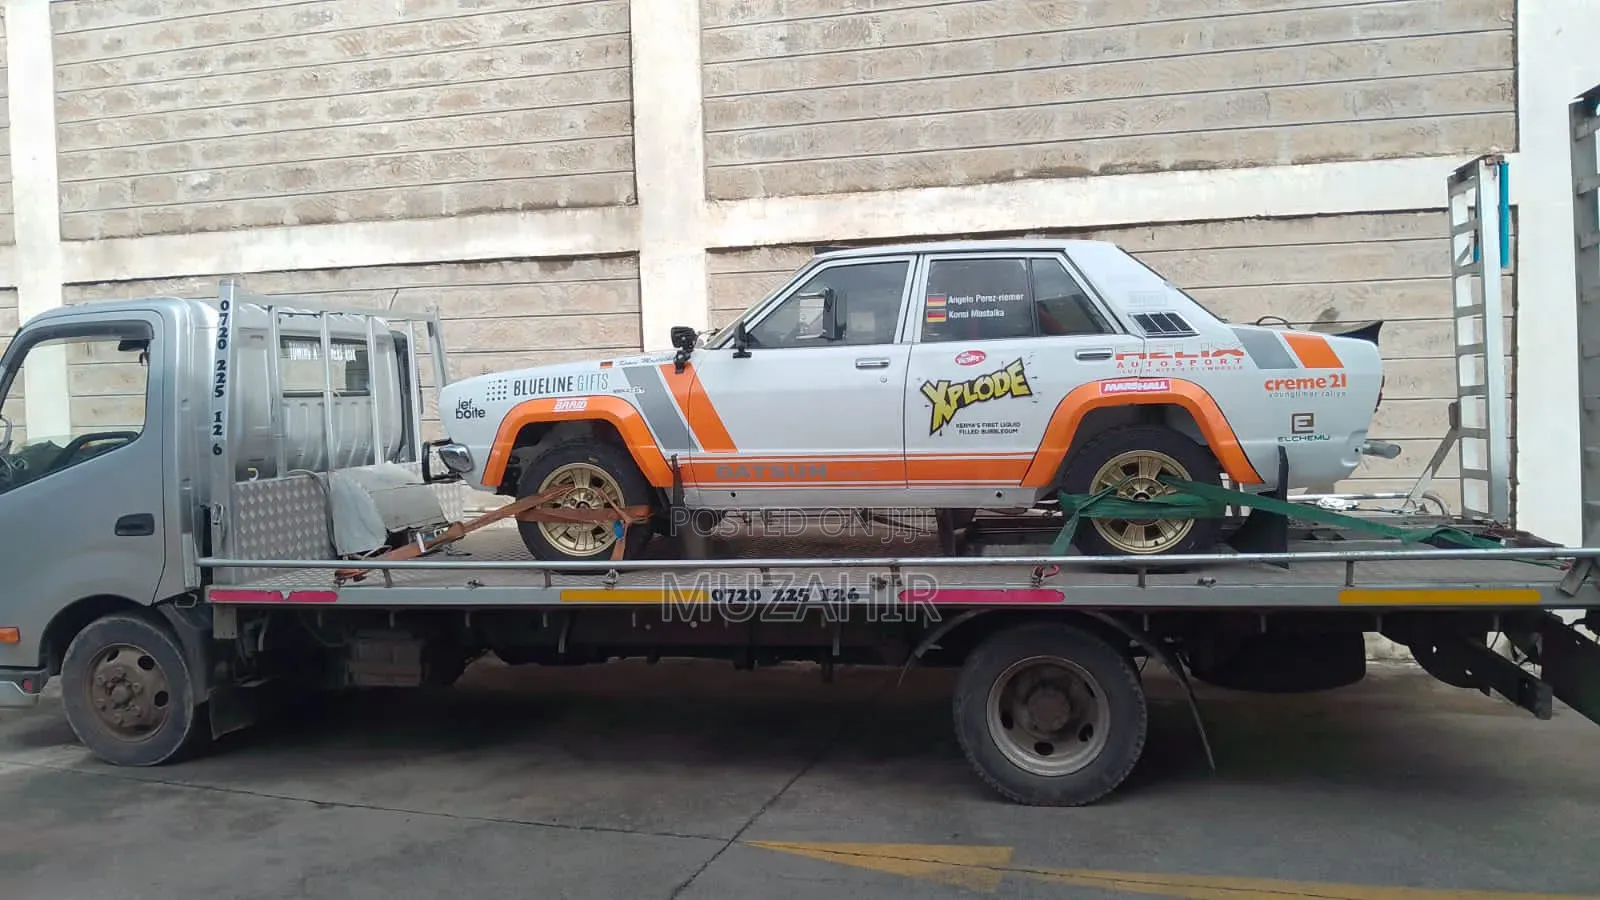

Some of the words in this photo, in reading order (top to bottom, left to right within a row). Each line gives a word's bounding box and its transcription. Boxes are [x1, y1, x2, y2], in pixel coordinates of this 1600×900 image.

[948, 295, 974, 305] Angelo
[216, 299, 230, 350] 0720
[1116, 358, 1243, 369] AUTOSPORT
[215, 359, 227, 398] 225
[513, 376, 573, 397] BLUELINE
[577, 373, 609, 391] GIFTS
[1104, 381, 1168, 392] MARSHALL
[1264, 377, 1327, 391] creme
[1329, 372, 1347, 388] 21
[921, 357, 1032, 436] XPLODE
[1277, 434, 1331, 442] ELCHEMU
[715, 463, 828, 480] DATSUN
[711, 588, 762, 603] 0720
[772, 588, 811, 603] 225
[820, 588, 861, 603] 126
